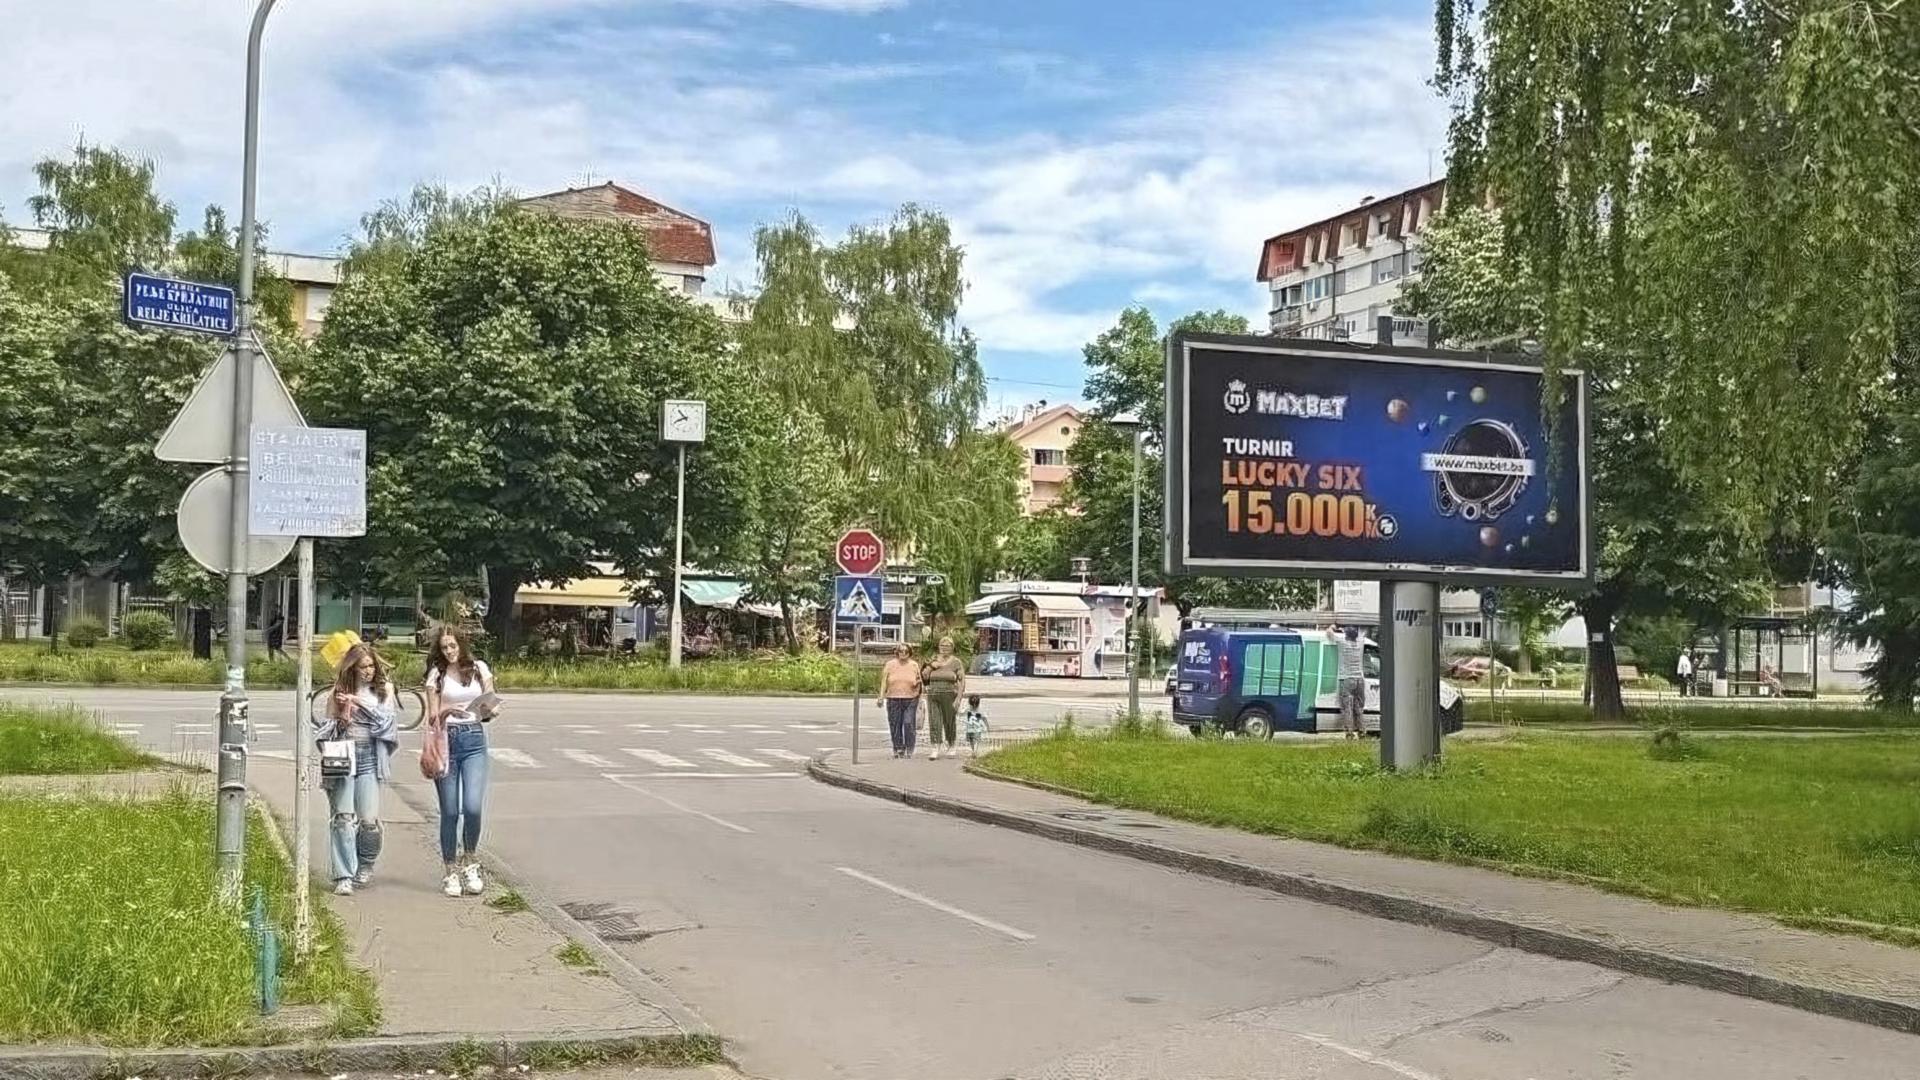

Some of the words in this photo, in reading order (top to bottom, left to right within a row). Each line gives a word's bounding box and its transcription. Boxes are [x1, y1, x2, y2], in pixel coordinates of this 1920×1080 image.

[1222, 437, 1294, 457] TURNIR
[1433, 457, 1525, 473] www.maxbet.ba
[1222, 460, 1311, 488] LUCKY
[1318, 464, 1362, 491] SIX
[1222, 489, 1365, 538] 15.000
[843, 544, 877, 561] STOP
